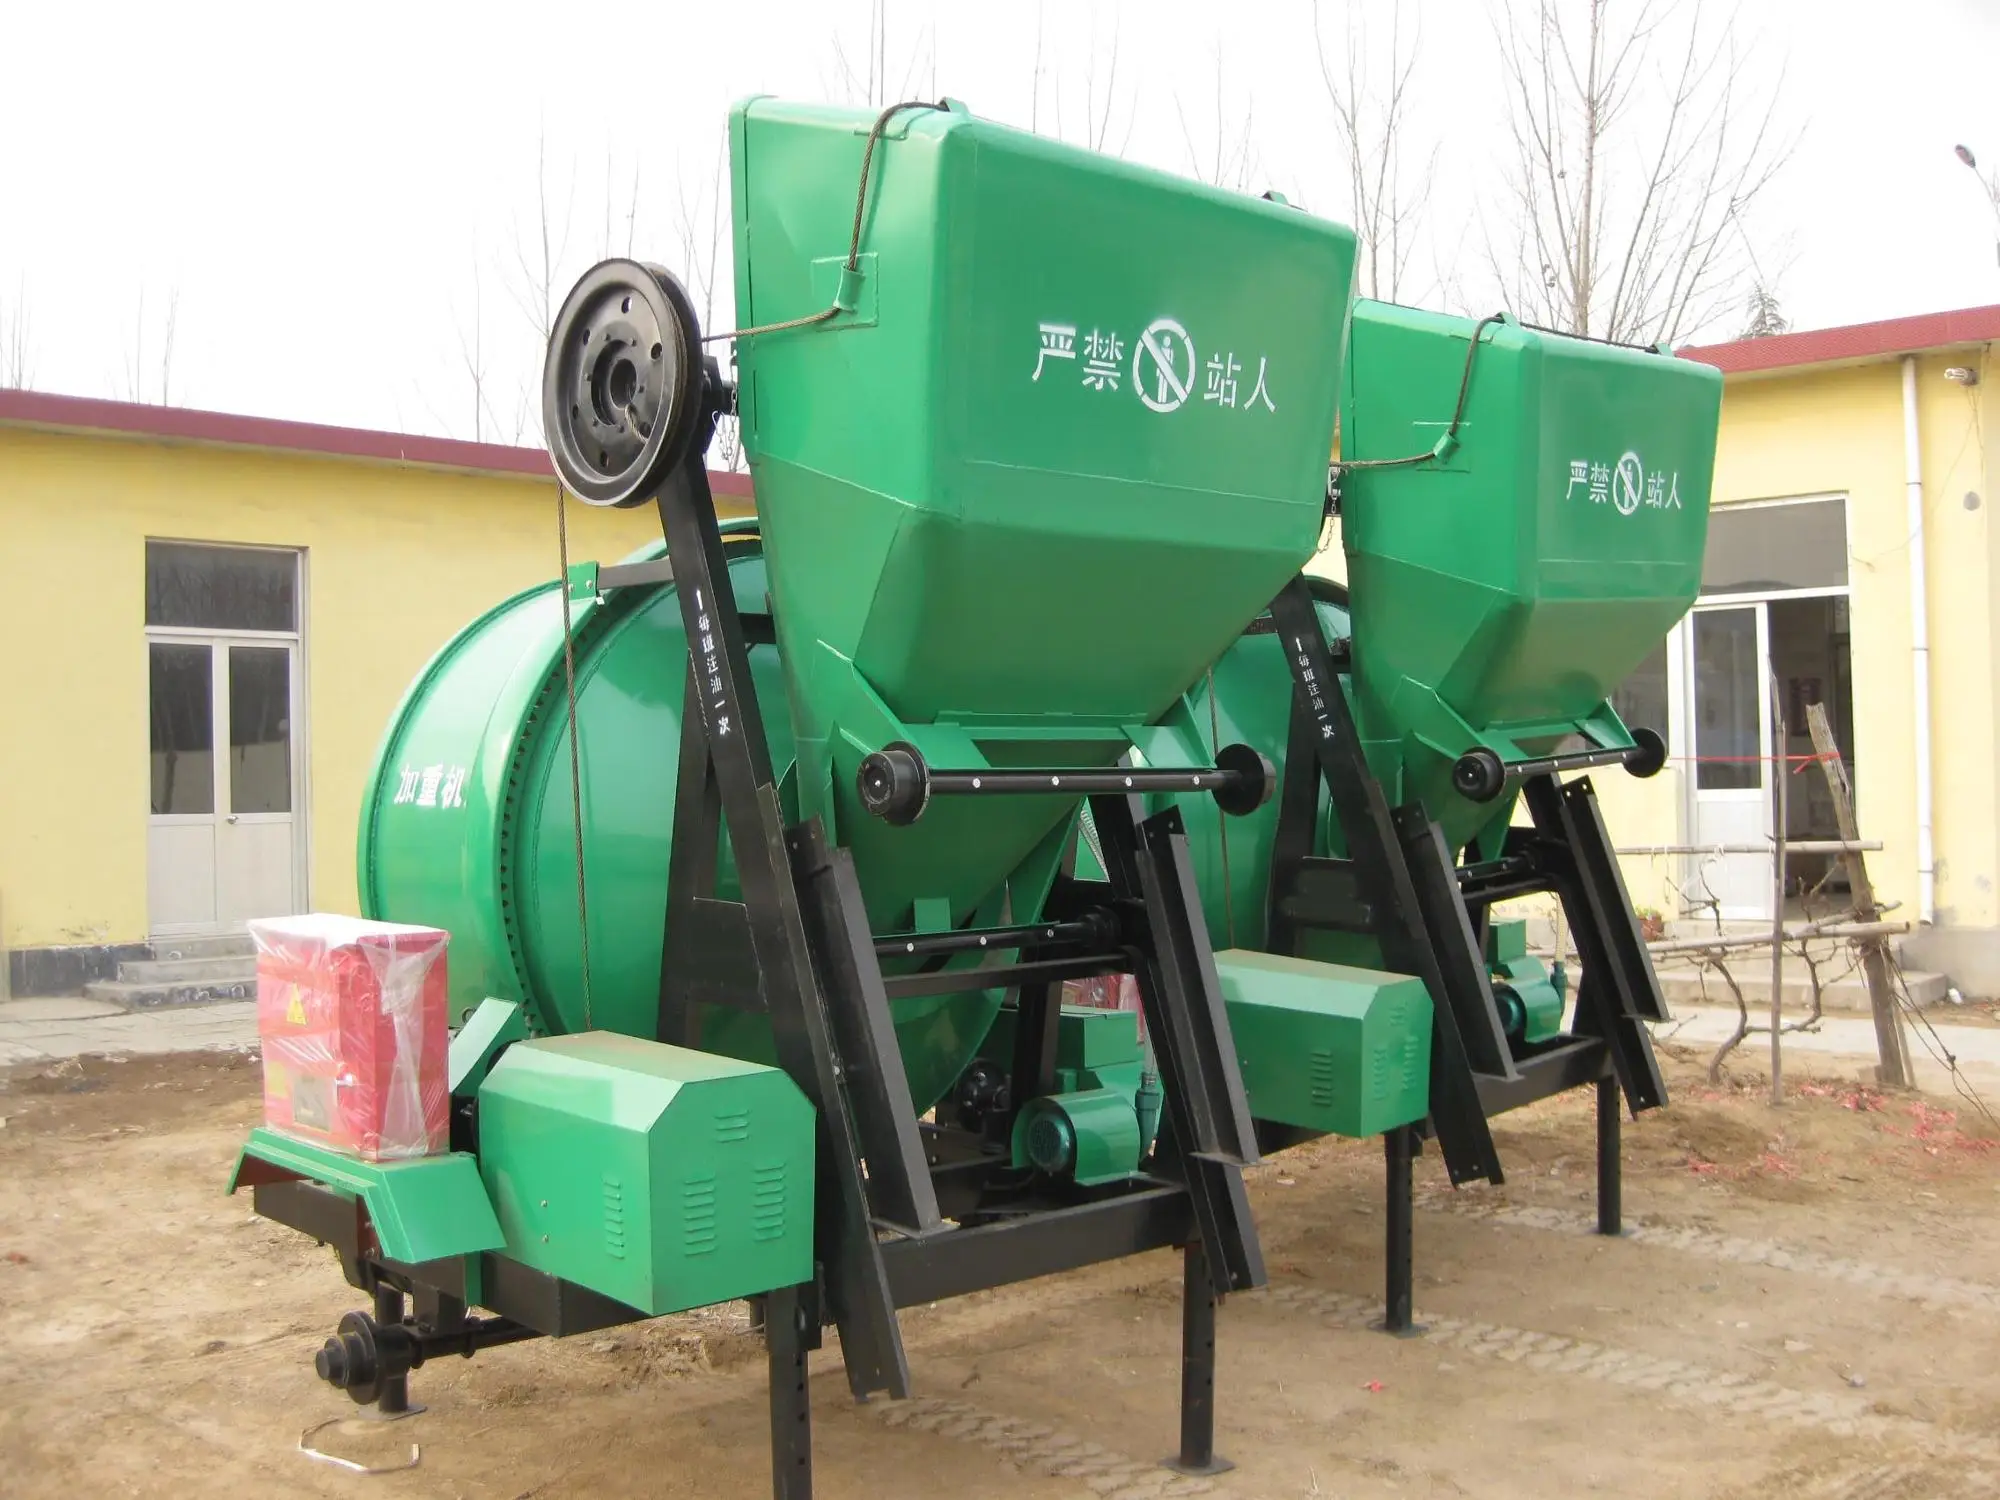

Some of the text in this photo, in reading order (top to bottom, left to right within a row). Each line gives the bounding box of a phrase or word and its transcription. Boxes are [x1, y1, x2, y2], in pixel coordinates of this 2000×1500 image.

[1032, 323, 1277, 413] 严禁 站人
[1566, 460, 1682, 510] 严禁 站人
